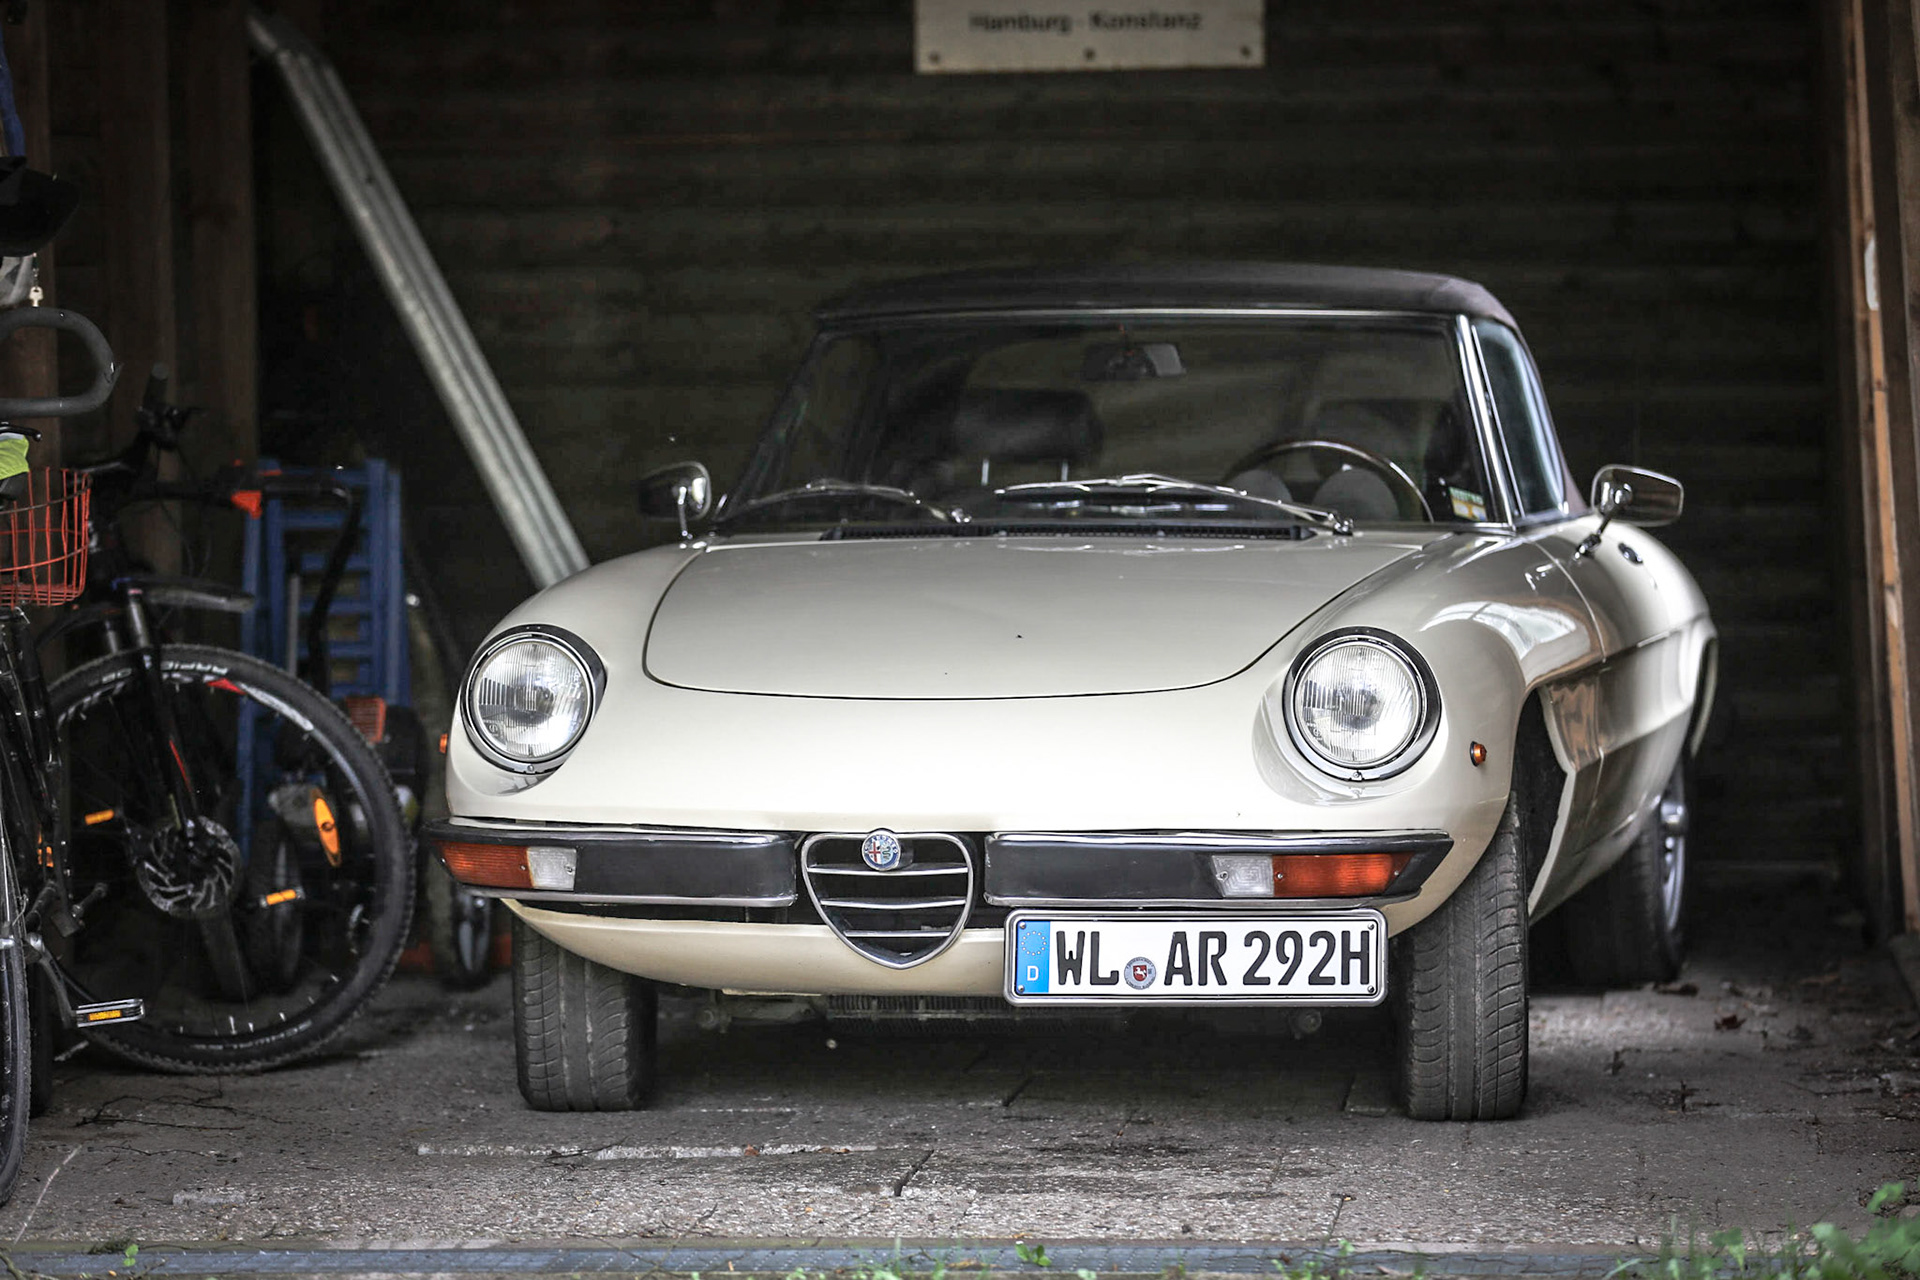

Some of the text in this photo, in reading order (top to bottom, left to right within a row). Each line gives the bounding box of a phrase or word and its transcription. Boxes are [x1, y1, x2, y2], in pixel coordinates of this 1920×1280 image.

[1026, 965, 1039, 981] D
[1056, 930, 1370, 986] WL AR 292H
